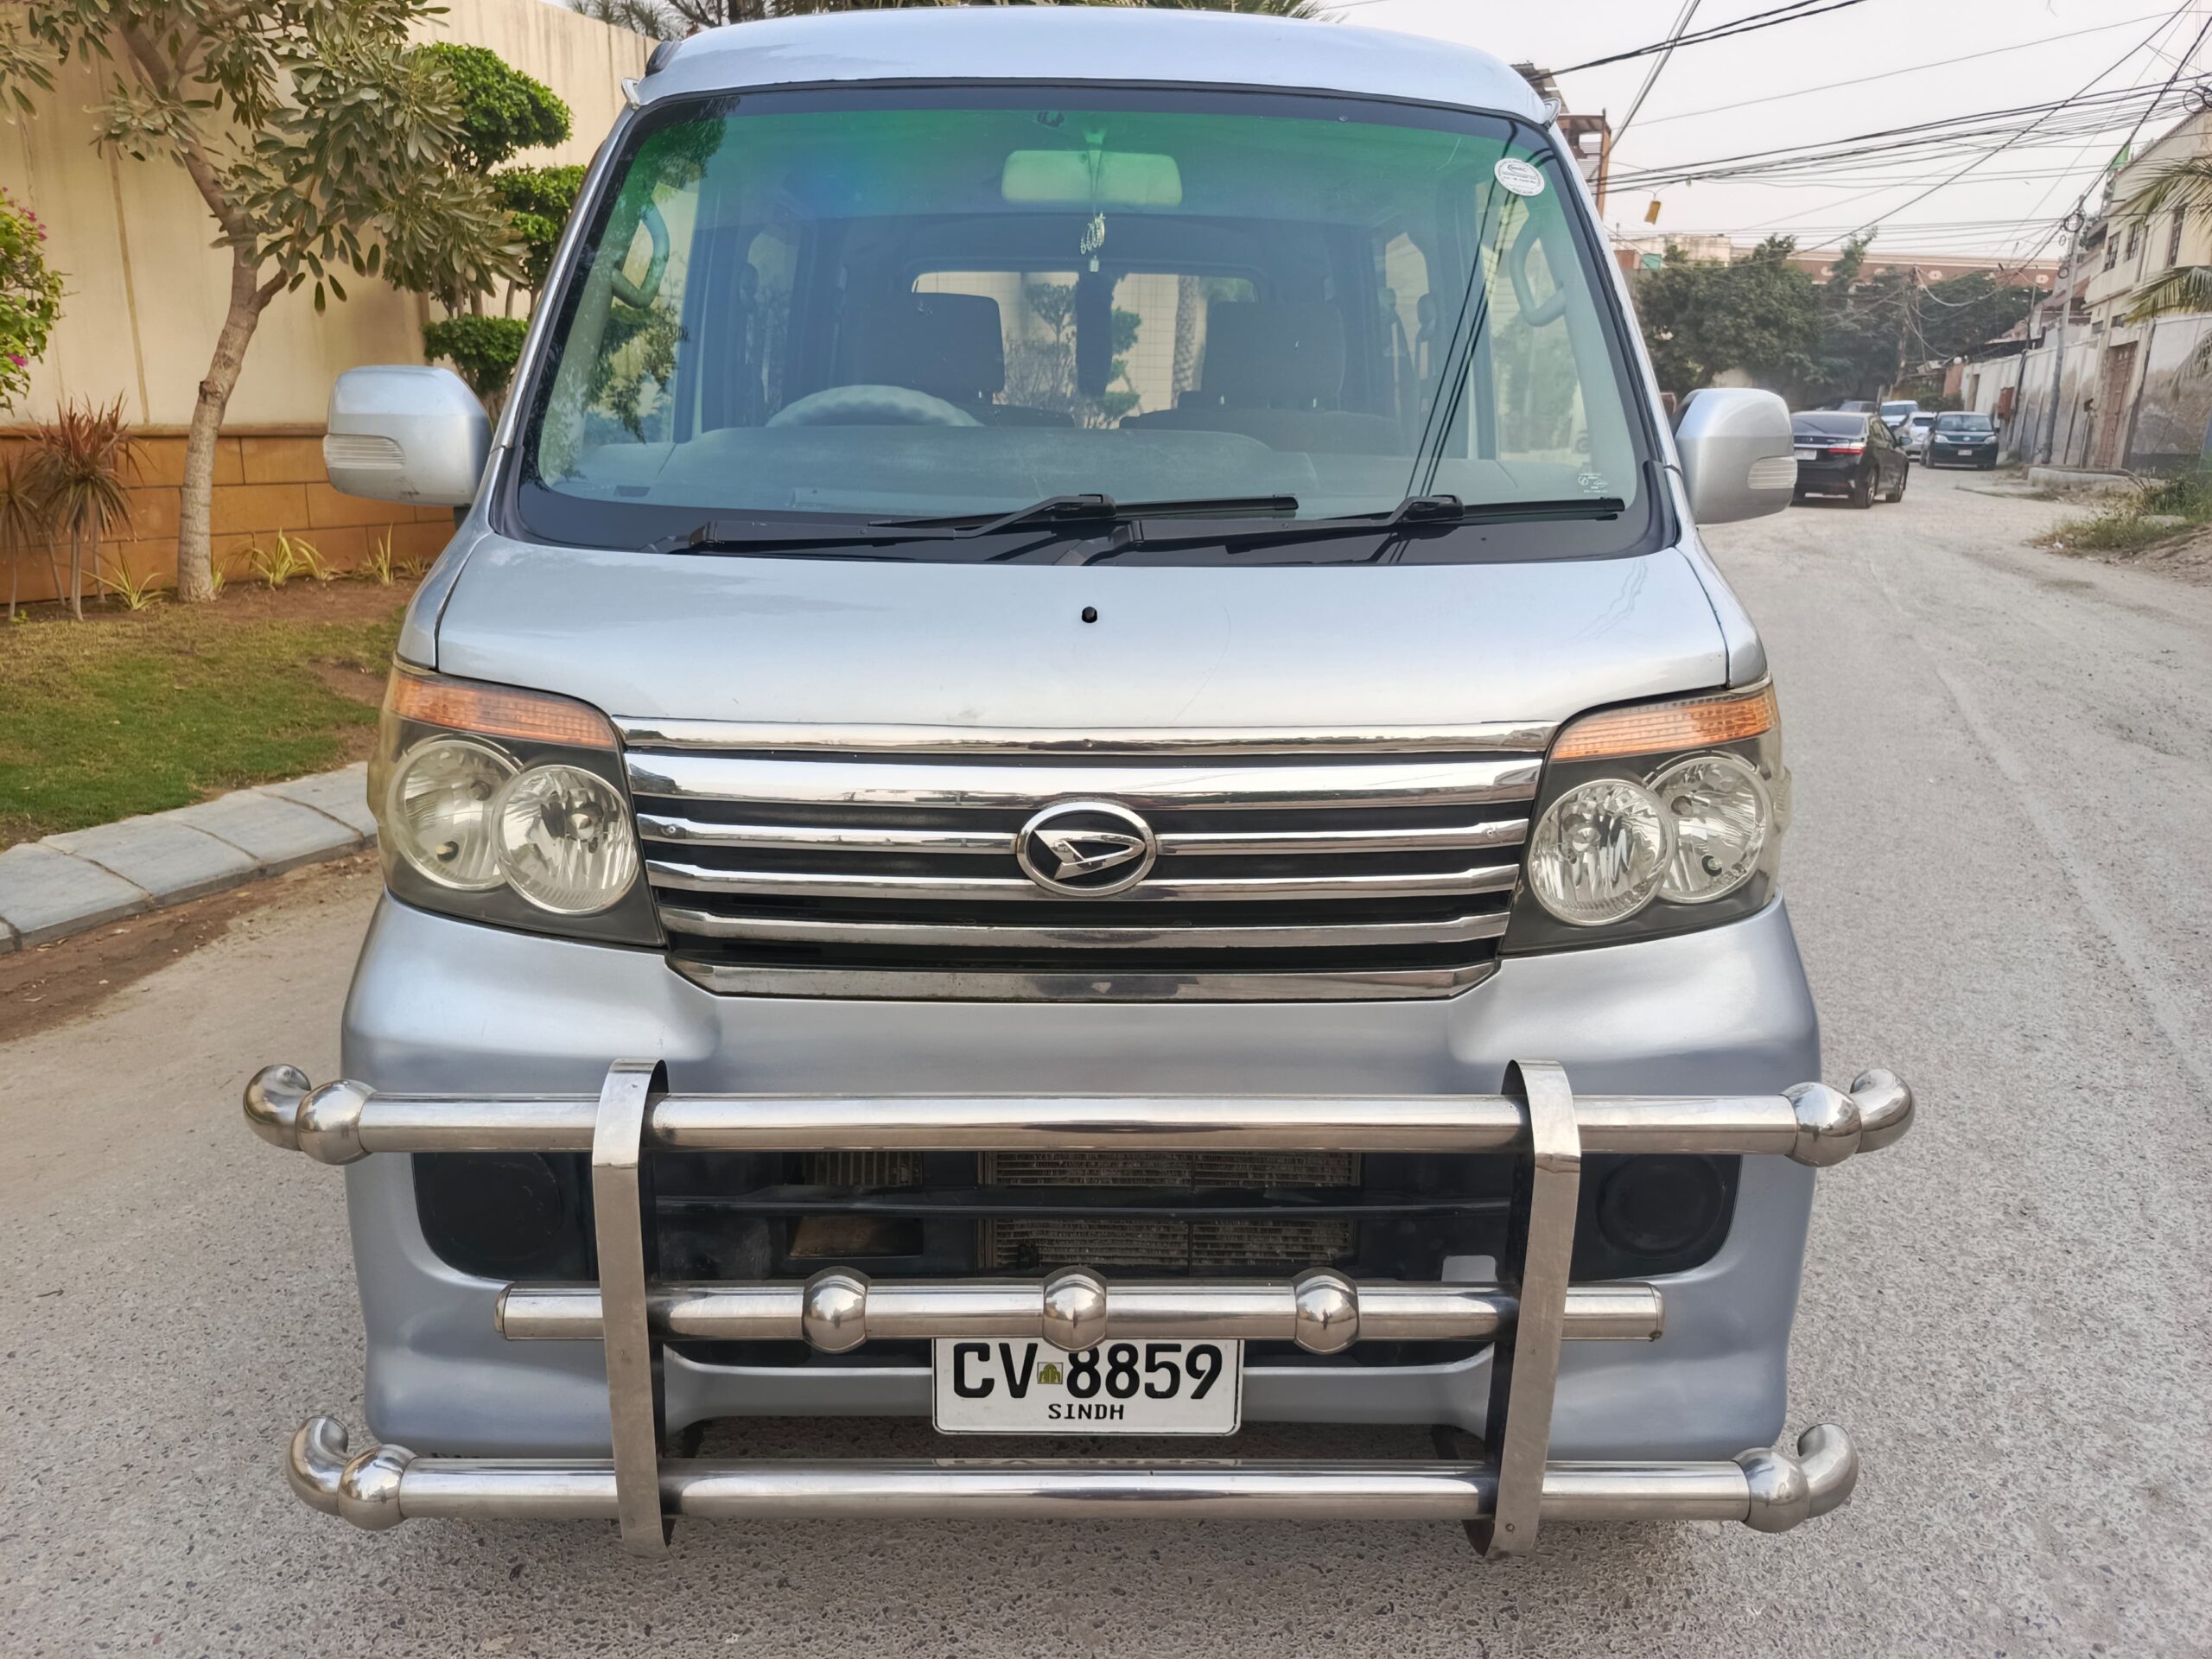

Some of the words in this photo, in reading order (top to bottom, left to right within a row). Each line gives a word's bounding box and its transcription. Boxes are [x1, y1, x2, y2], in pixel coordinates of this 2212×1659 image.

[953, 1342, 1038, 1399] CV
[1065, 1343, 1223, 1400] 8859
[1047, 1403, 1125, 1420] SINDH
